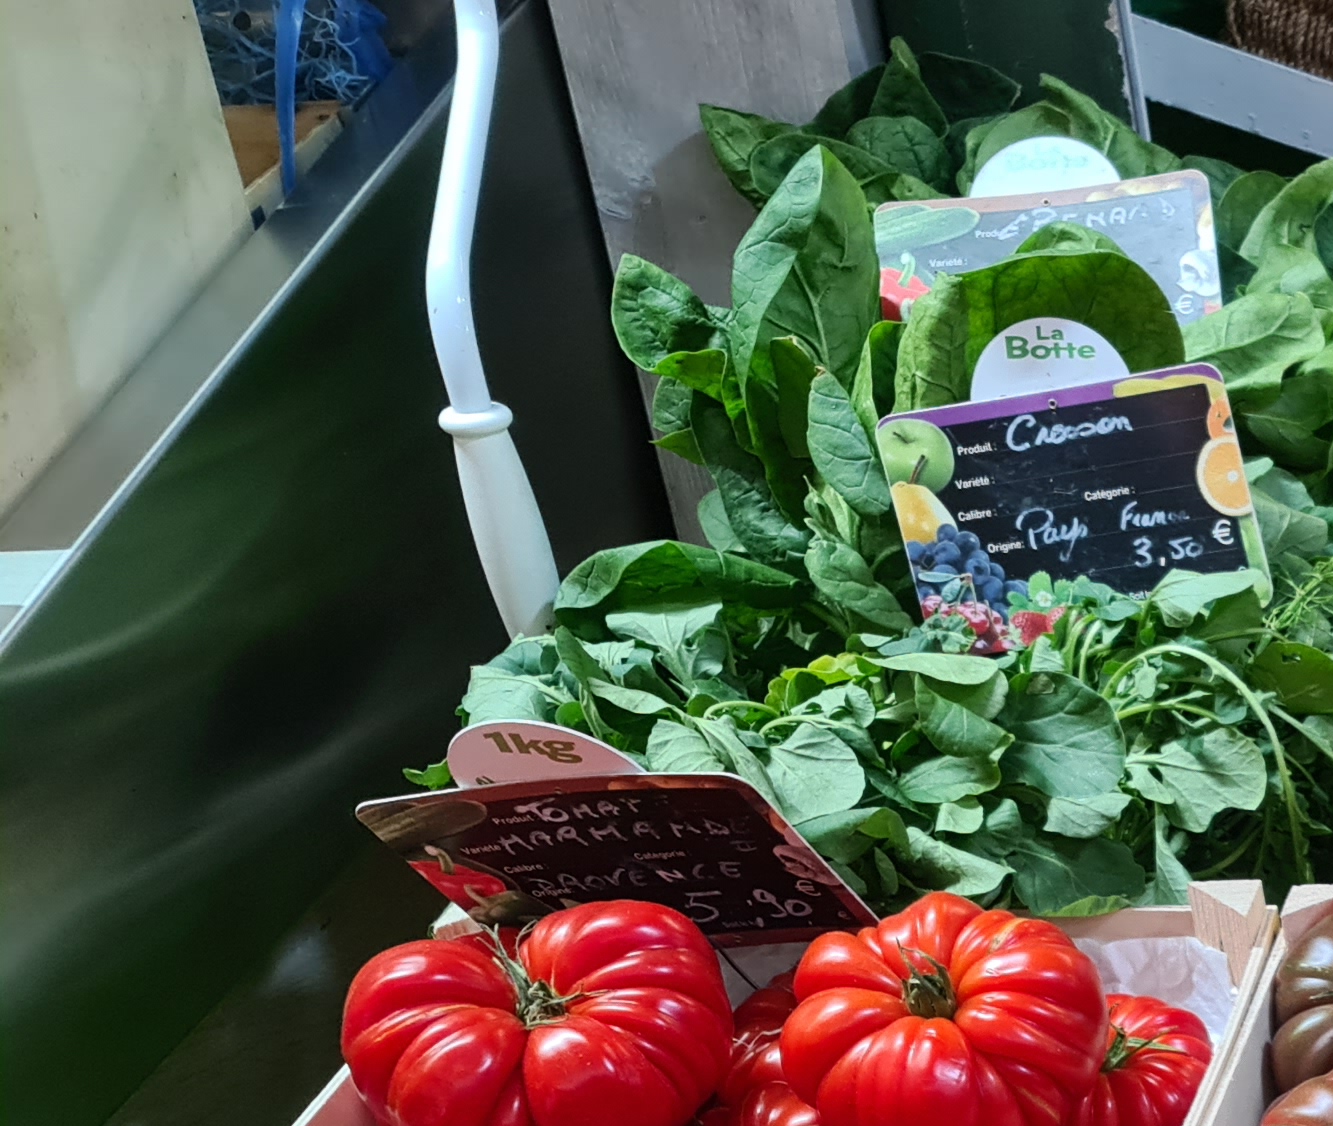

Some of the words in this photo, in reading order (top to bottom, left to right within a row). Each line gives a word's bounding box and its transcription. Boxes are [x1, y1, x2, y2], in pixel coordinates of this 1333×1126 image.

[1175, 294, 1194, 314] €
[1036, 326, 1064, 340] La
[1005, 336, 1096, 360] Botte
[1006, 414, 1133, 451] Cresson
[1212, 519, 1234, 545] €
[483, 731, 583, 764] 1kg
[795, 880, 821, 897] €
